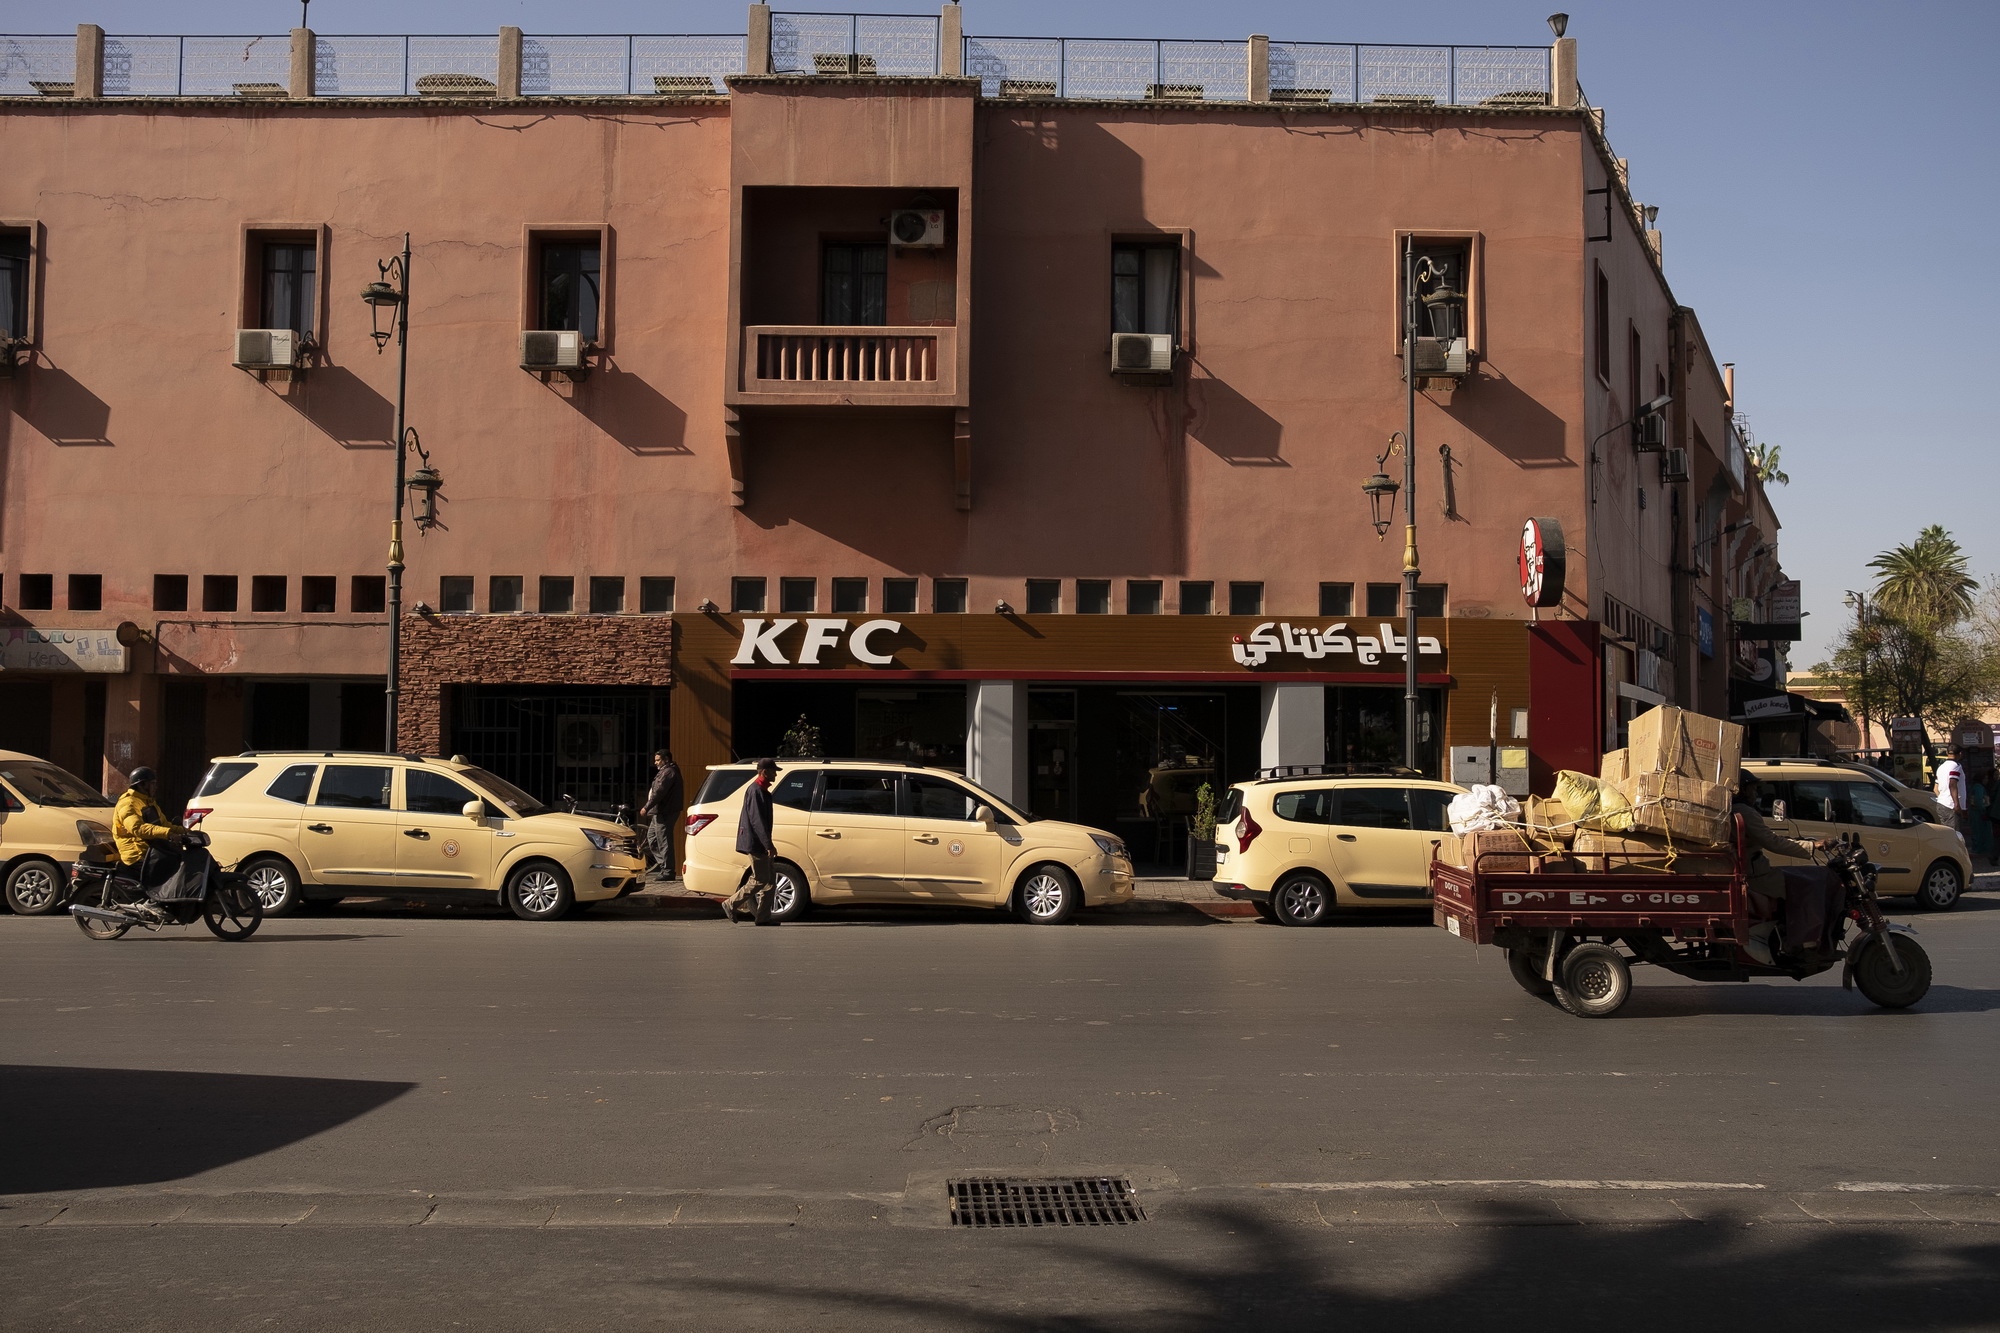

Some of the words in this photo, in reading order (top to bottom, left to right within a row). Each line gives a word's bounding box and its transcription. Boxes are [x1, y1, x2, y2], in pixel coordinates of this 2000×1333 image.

[730, 618, 902, 665] KFC
[1232, 622, 1353, 667] كنتاكي
[28, 651, 70, 666] Keno
[1695, 739, 1714, 750] Oral
[1621, 893, 1700, 904] ccles
